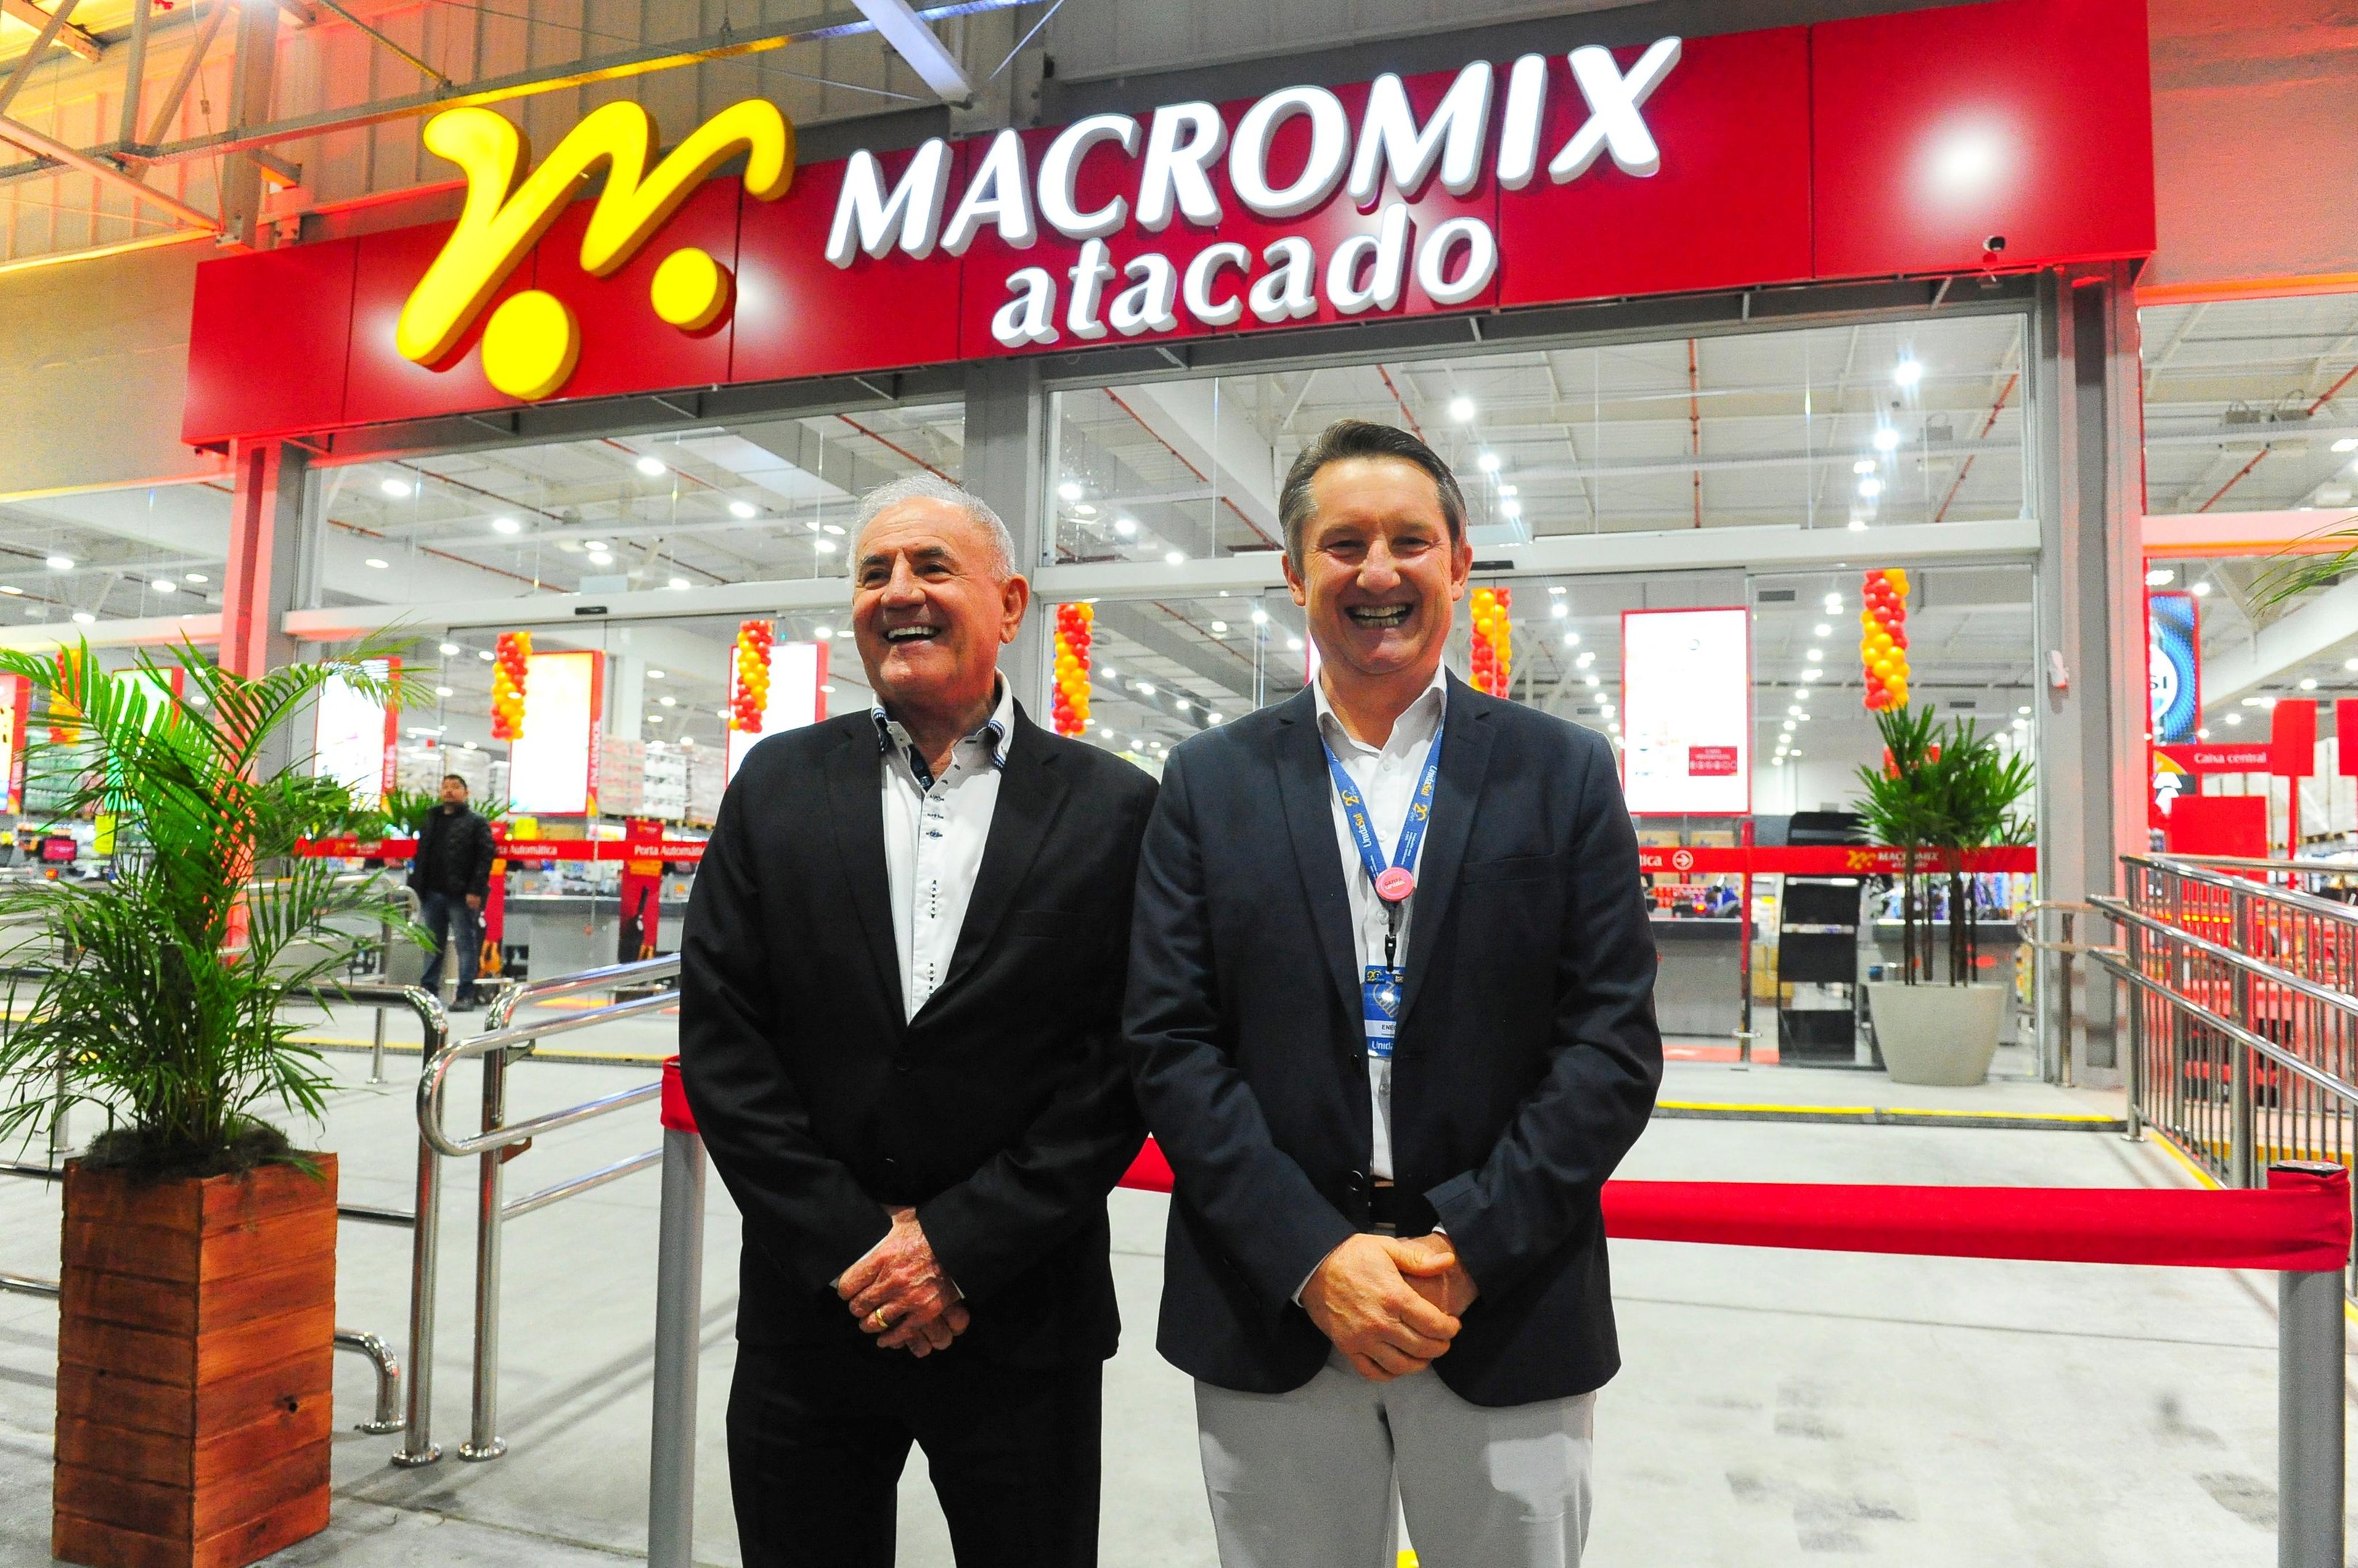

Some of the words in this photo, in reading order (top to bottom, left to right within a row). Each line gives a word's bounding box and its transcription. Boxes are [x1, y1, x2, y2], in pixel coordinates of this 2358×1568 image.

[825, 36, 1681, 267] MACROMIX
[991, 200, 1497, 348] atacado
[2193, 752, 2225, 764] Caixa
[2226, 751, 2267, 764] central
[1420, 764, 1437, 797] UnidaSul
[1353, 812, 1372, 848] UnidaSul
[634, 844, 659, 856] Porta
